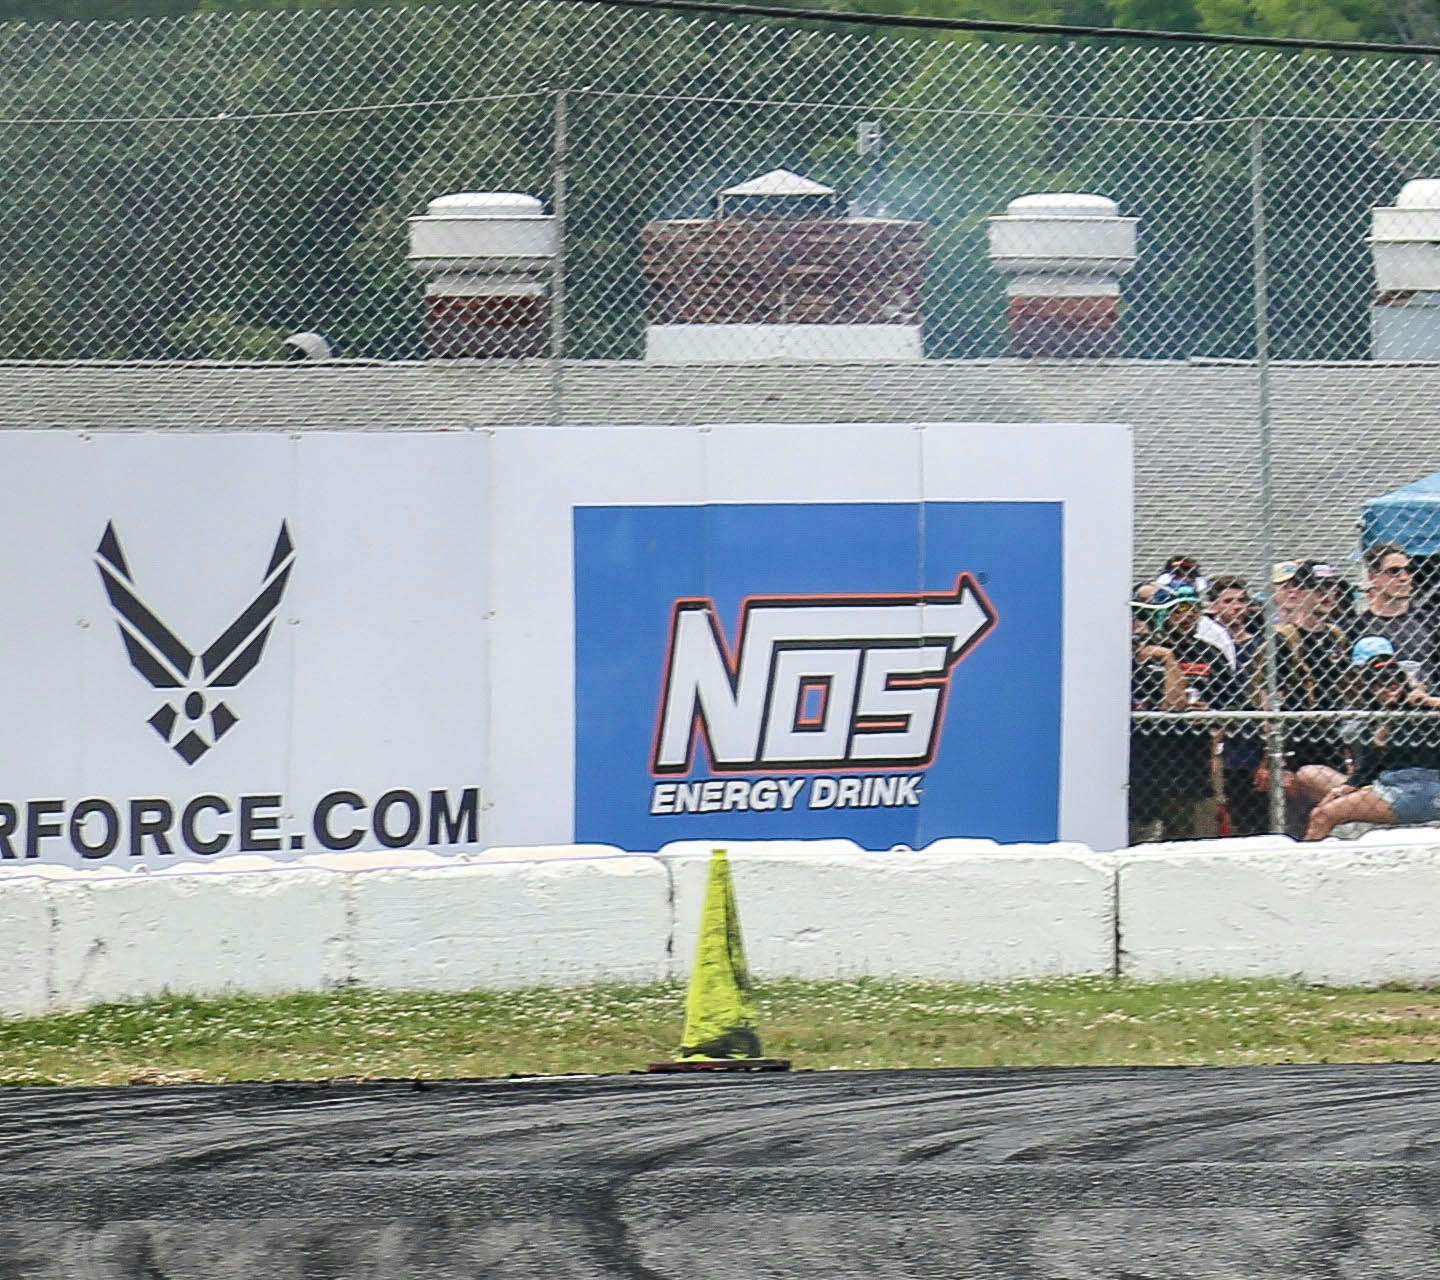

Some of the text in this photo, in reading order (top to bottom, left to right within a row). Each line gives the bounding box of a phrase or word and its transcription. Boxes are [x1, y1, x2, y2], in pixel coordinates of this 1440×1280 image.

[653, 572, 998, 775] NOS
[650, 773, 922, 815] ENERGY DRINK
